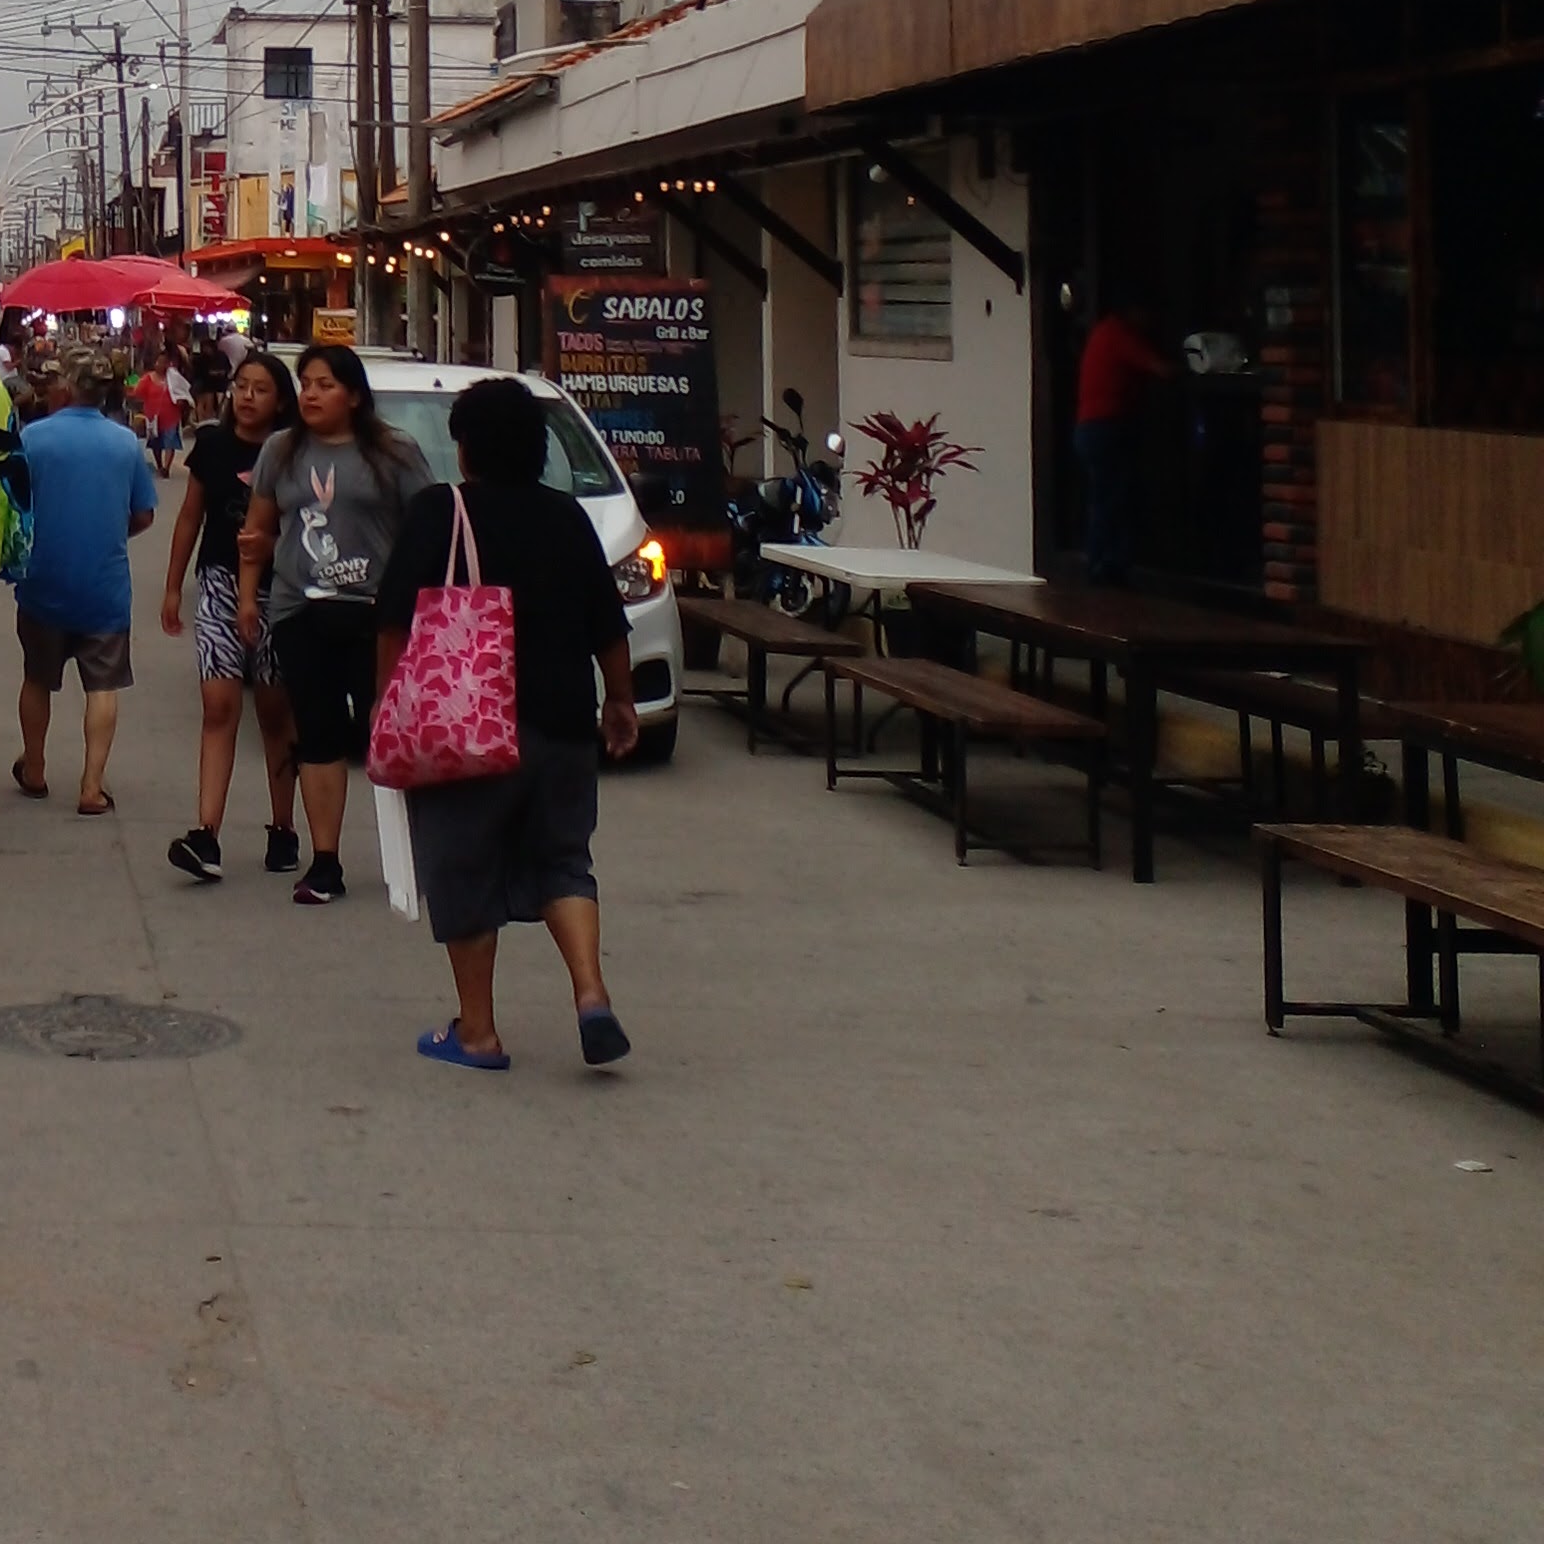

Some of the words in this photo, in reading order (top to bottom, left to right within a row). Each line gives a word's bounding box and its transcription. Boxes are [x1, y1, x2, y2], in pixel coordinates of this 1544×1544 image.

[579, 254, 644, 268] comidas
[602, 295, 706, 322] SABALOS
[557, 331, 605, 352] TACOS
[687, 326, 711, 341] Bar
[559, 354, 649, 373] BURRITOS
[560, 373, 691, 395] HAMBURGUESAS
[611, 429, 666, 445] FUNDIDO
[645, 445, 703, 462] TABLITA
[333, 569, 367, 584] UNES
